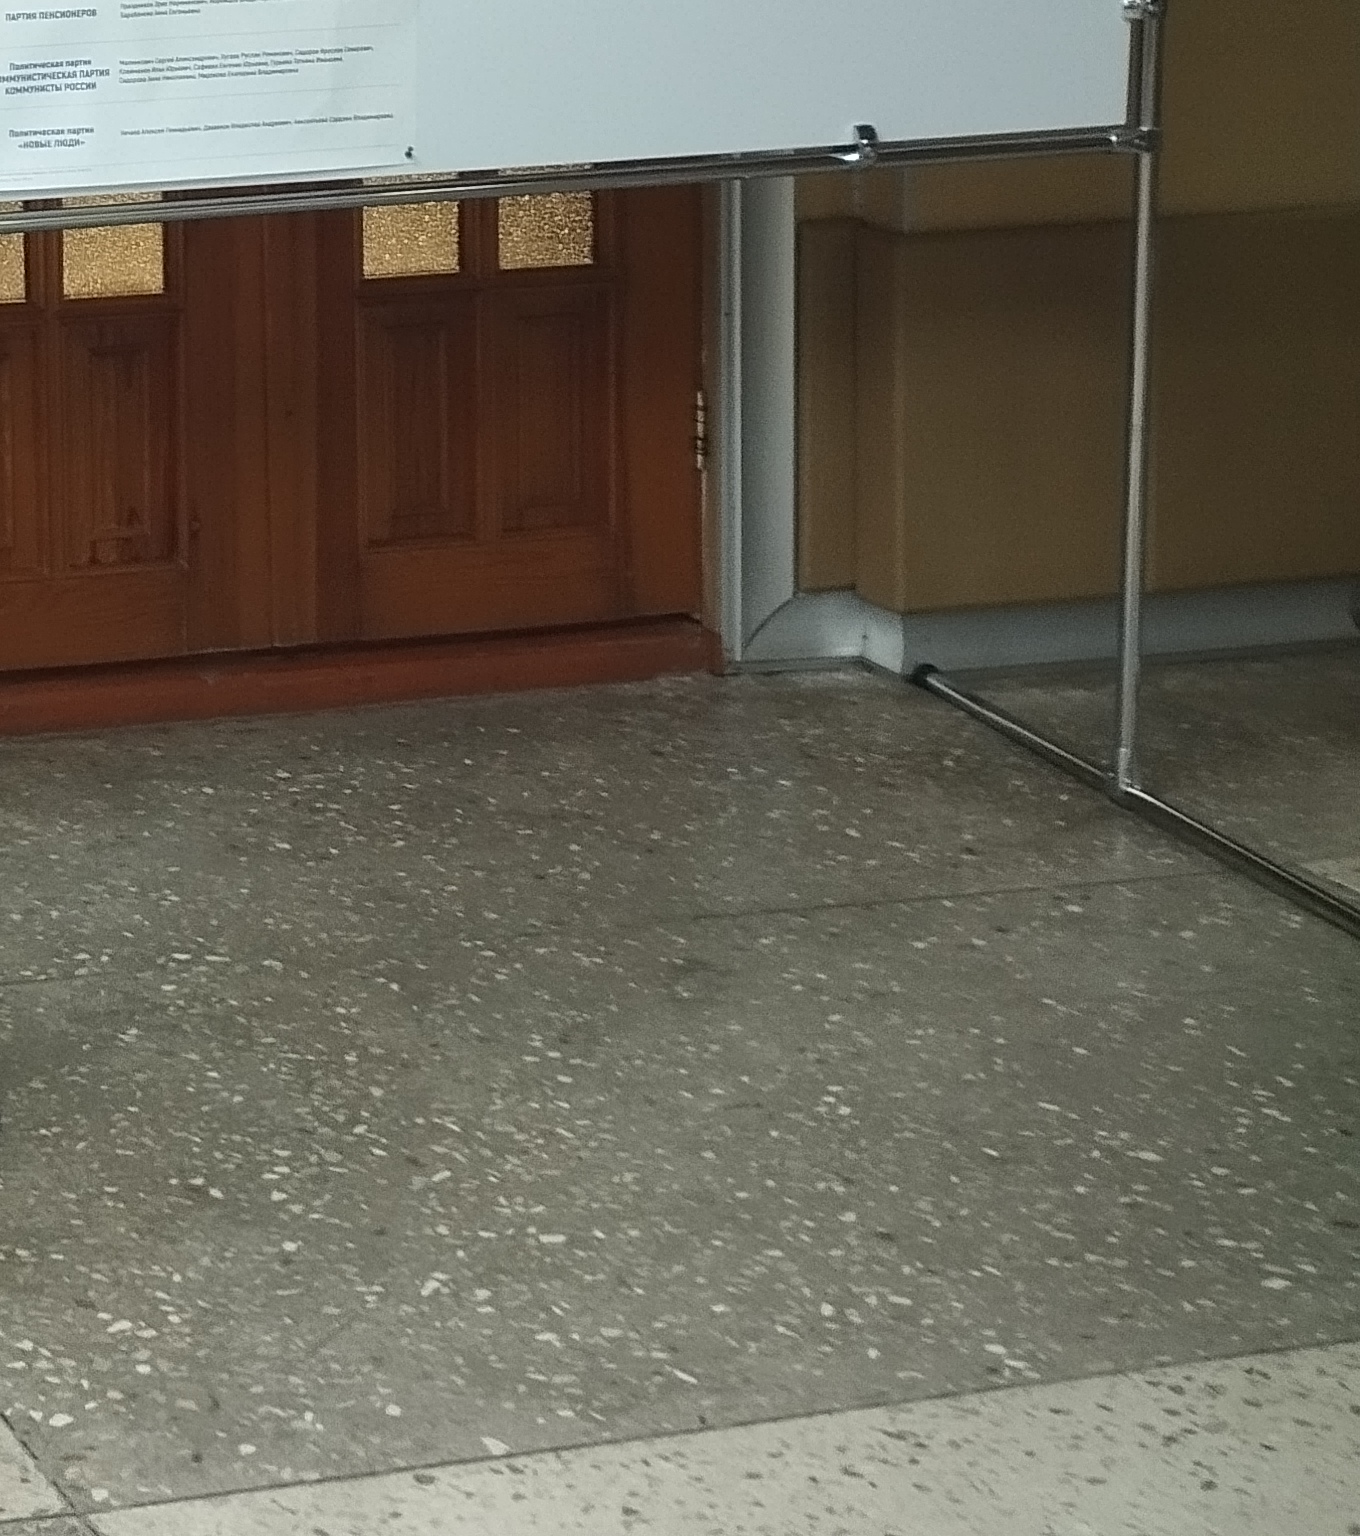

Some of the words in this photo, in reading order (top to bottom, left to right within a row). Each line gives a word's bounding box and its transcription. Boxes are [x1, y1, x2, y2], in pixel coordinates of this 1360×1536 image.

[5, 11, 37, 22] ПАРТИЯ
[38, 9, 97, 21] ПЕНСИОНЕРОВ
[9, 61, 63, 72] Политическая
[65, 59, 92, 70] партия
[79, 68, 110, 80] ПАРТИЯ
[5, 83, 63, 96] КОММУНИСТЫ
[64, 81, 97, 93] РОССИИ
[9, 128, 65, 138] Политическая
[67, 126, 95, 137] партия
